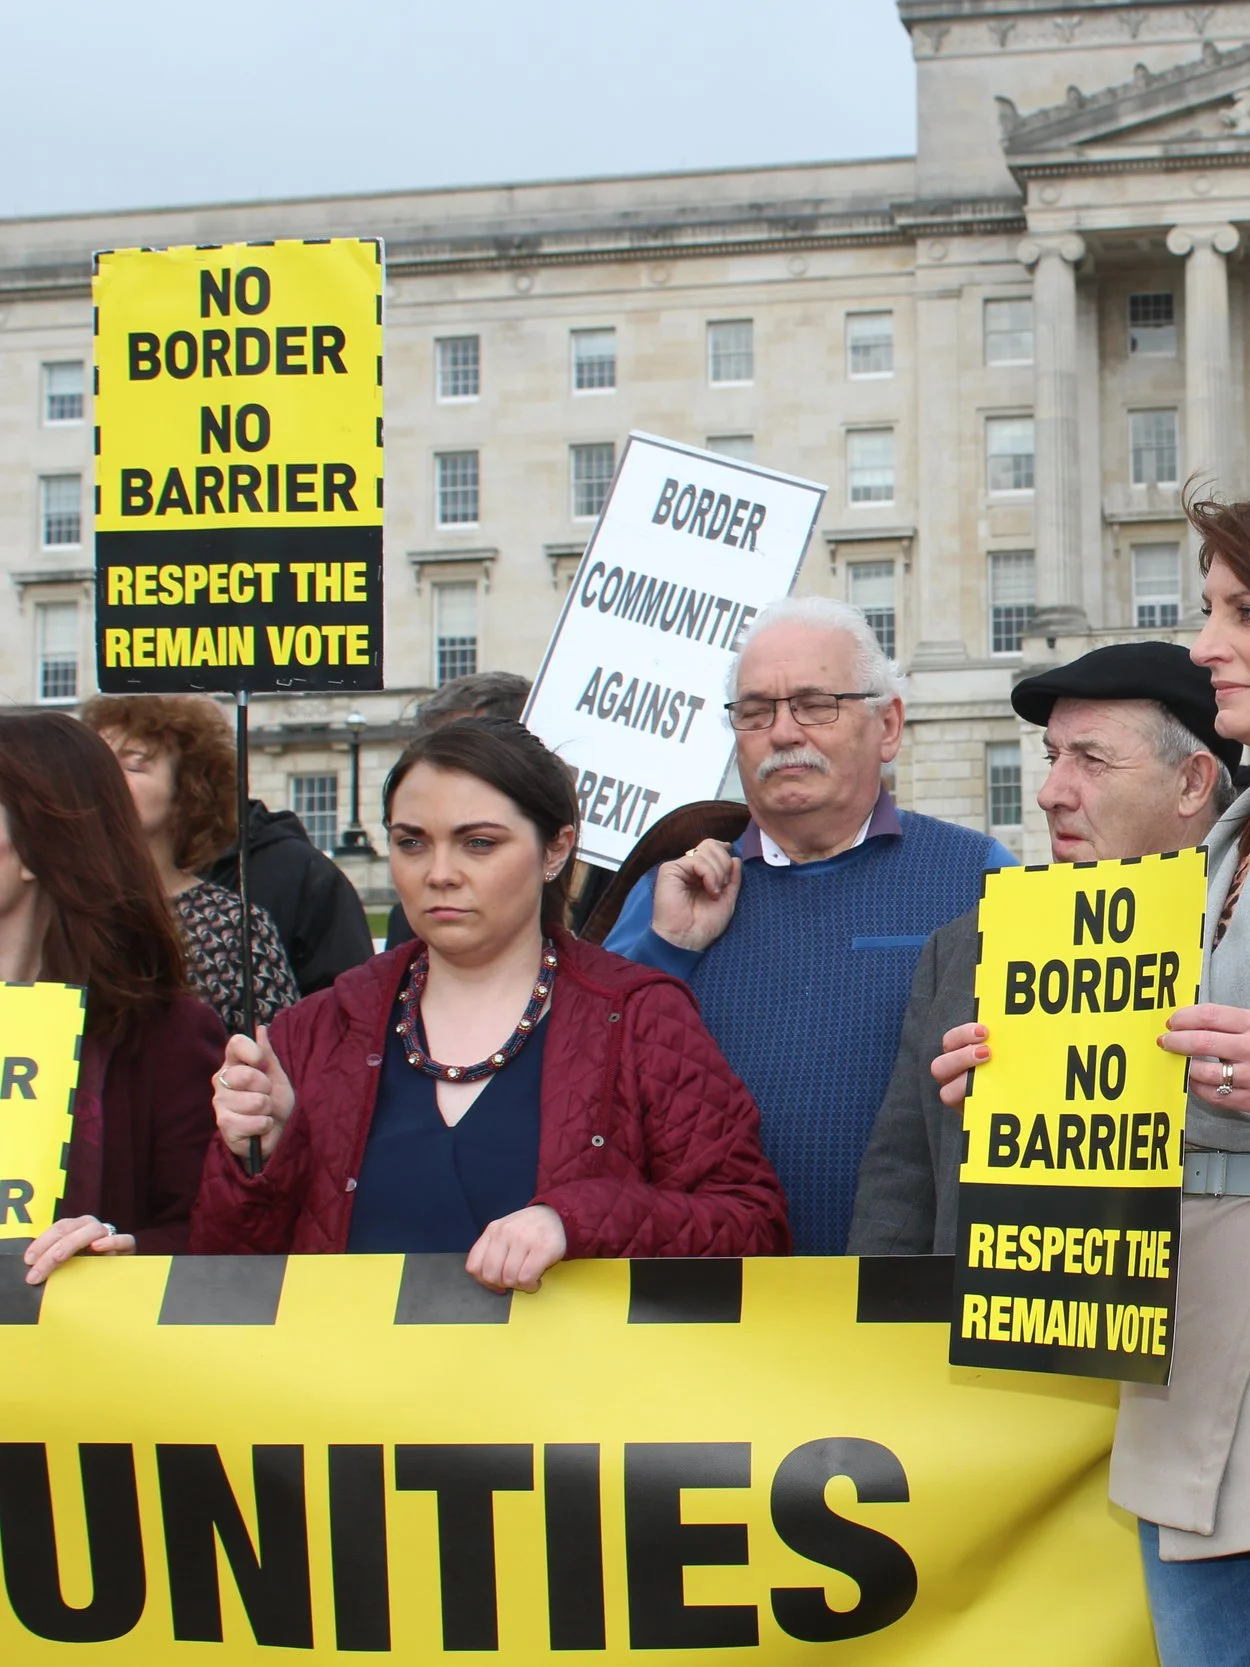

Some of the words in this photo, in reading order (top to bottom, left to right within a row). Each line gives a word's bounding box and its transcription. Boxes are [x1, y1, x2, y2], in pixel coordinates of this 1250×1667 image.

[200, 266, 271, 318] NO
[128, 325, 348, 381] BORDER
[200, 403, 271, 454] NO
[120, 463, 358, 516] BARRIER
[652, 477, 767, 552] BORDER
[107, 563, 280, 606] RESPECT
[290, 561, 367, 603] THE
[580, 561, 758, 653] COMMUNITIE
[105, 625, 255, 668] REMAIN
[265, 624, 370, 666] VOTE
[576, 666, 706, 744] AGAINST
[567, 764, 661, 838] REXIT
[1073, 886, 1136, 946] NO
[1004, 950, 1180, 1016] BORDER
[1065, 1043, 1127, 1101] NO
[987, 1111, 1171, 1171] BARRIER
[968, 1223, 1120, 1277] RESPECT
[1126, 1229, 1172, 1280] THE
[961, 1294, 1098, 1350] REMAIN
[1106, 1303, 1168, 1356] VOTE
[0, 1436, 919, 1653] UNITIES
